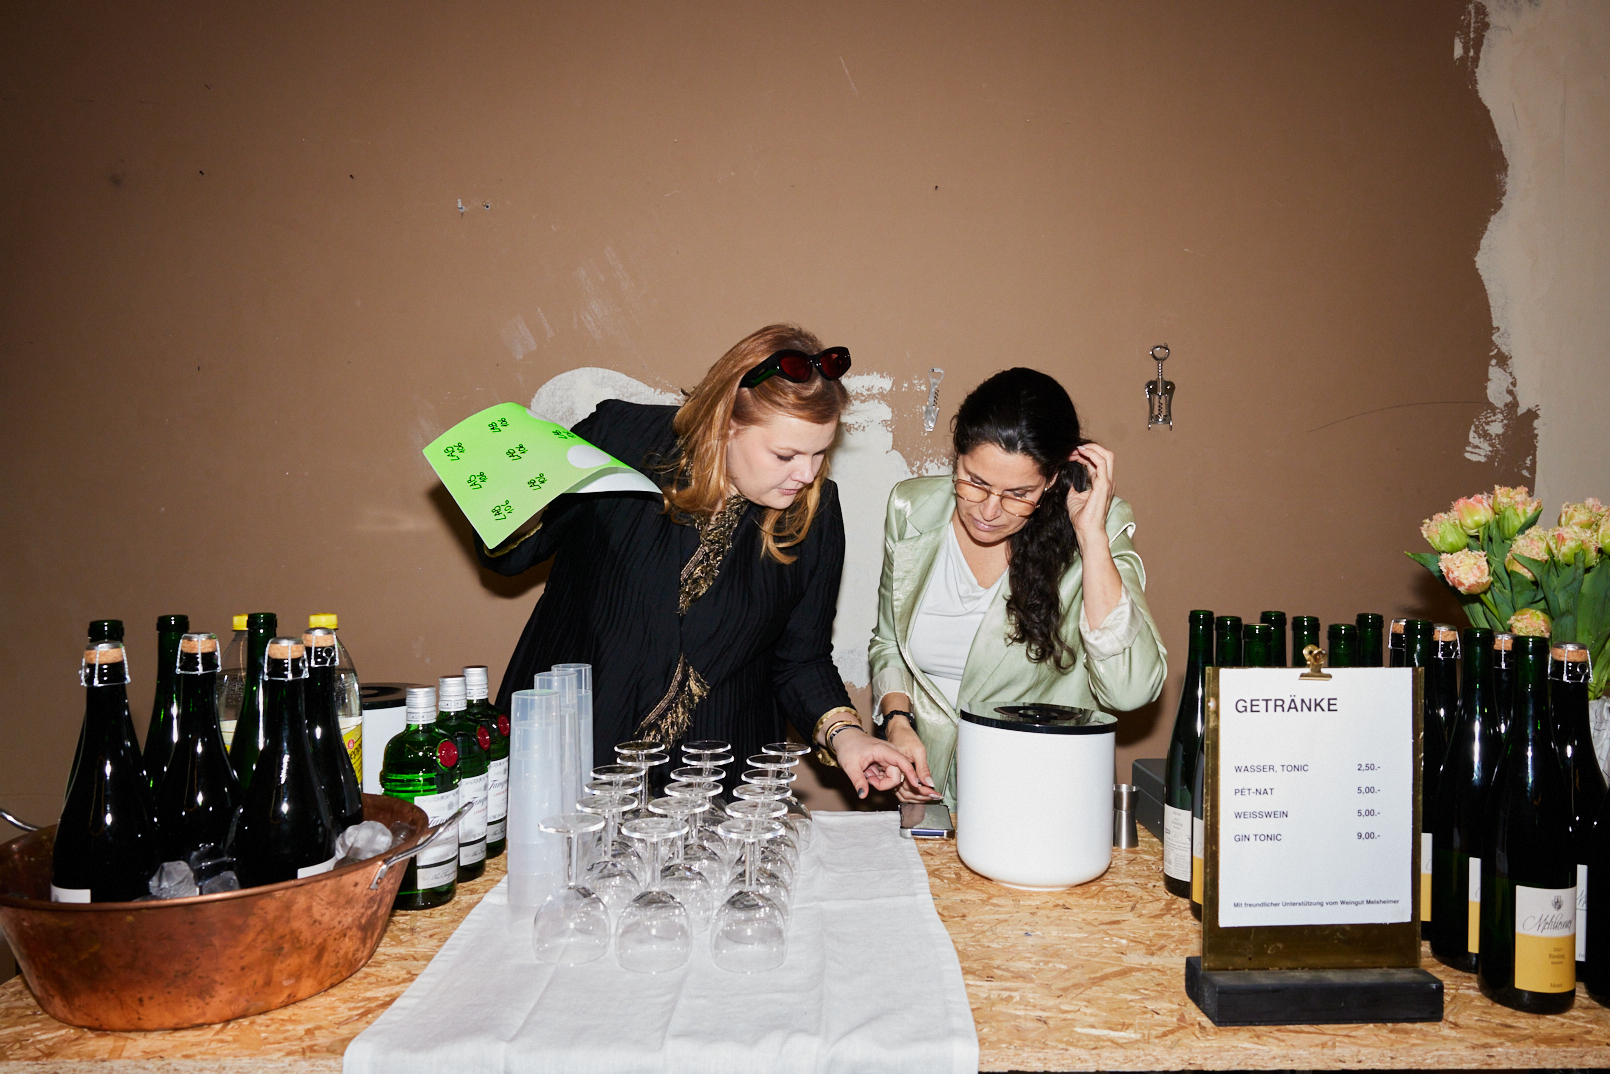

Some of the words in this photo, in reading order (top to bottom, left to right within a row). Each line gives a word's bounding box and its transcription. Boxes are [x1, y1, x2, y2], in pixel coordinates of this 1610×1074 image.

[488, 421, 501, 433] LAB
[444, 446, 460, 461] LAB
[506, 448, 521, 460] LAB
[467, 475, 482, 490] LAB
[528, 478, 541, 490] LAB
[491, 506, 506, 521] LAB
[1235, 695, 1338, 713] GETRÄNKE
[1234, 765, 1278, 774] WASSER,
[1281, 764, 1309, 773] TONIC
[1357, 763, 1381, 772] 2,50.-
[1235, 787, 1275, 797] PÉT-NAT
[1357, 786, 1381, 795] 5,00.-
[1234, 811, 1289, 820] WEISSWEIN
[1357, 809, 1381, 818] 5,00.-
[1234, 834, 1251, 843] GIN
[1253, 834, 1283, 842] TONIC
[1357, 832, 1381, 841] 9,00.-
[1282, 900, 1325, 908] Unterstützung
[1340, 899, 1365, 907] Weingut
